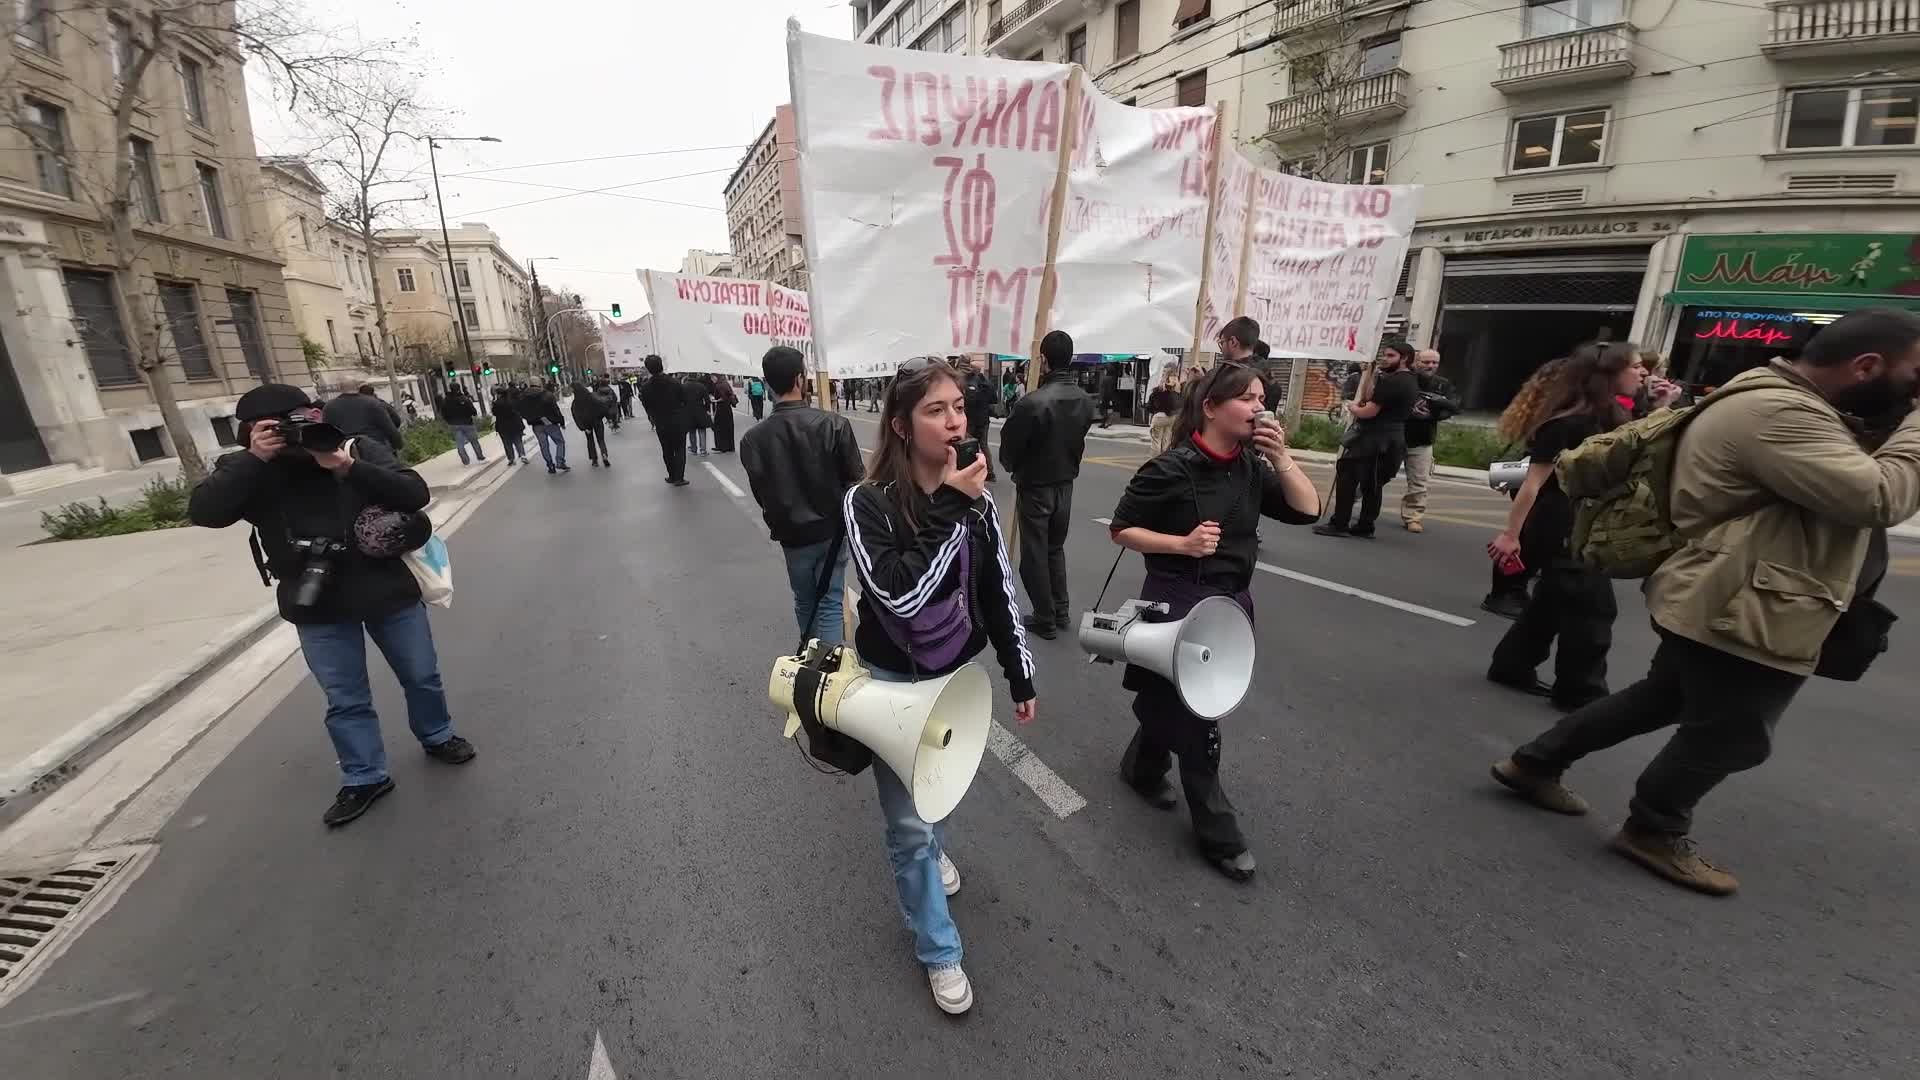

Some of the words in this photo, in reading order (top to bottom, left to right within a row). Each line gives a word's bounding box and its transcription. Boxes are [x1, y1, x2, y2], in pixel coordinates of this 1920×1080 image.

[1464, 225, 1533, 242] ΜΕΓΑΡΟΝ
[1548, 221, 1639, 237] ΠΑΛΛΑΔΟΣ
[1726, 311, 1740, 320] ΤΟ
[780, 668, 797, 680] SUP
